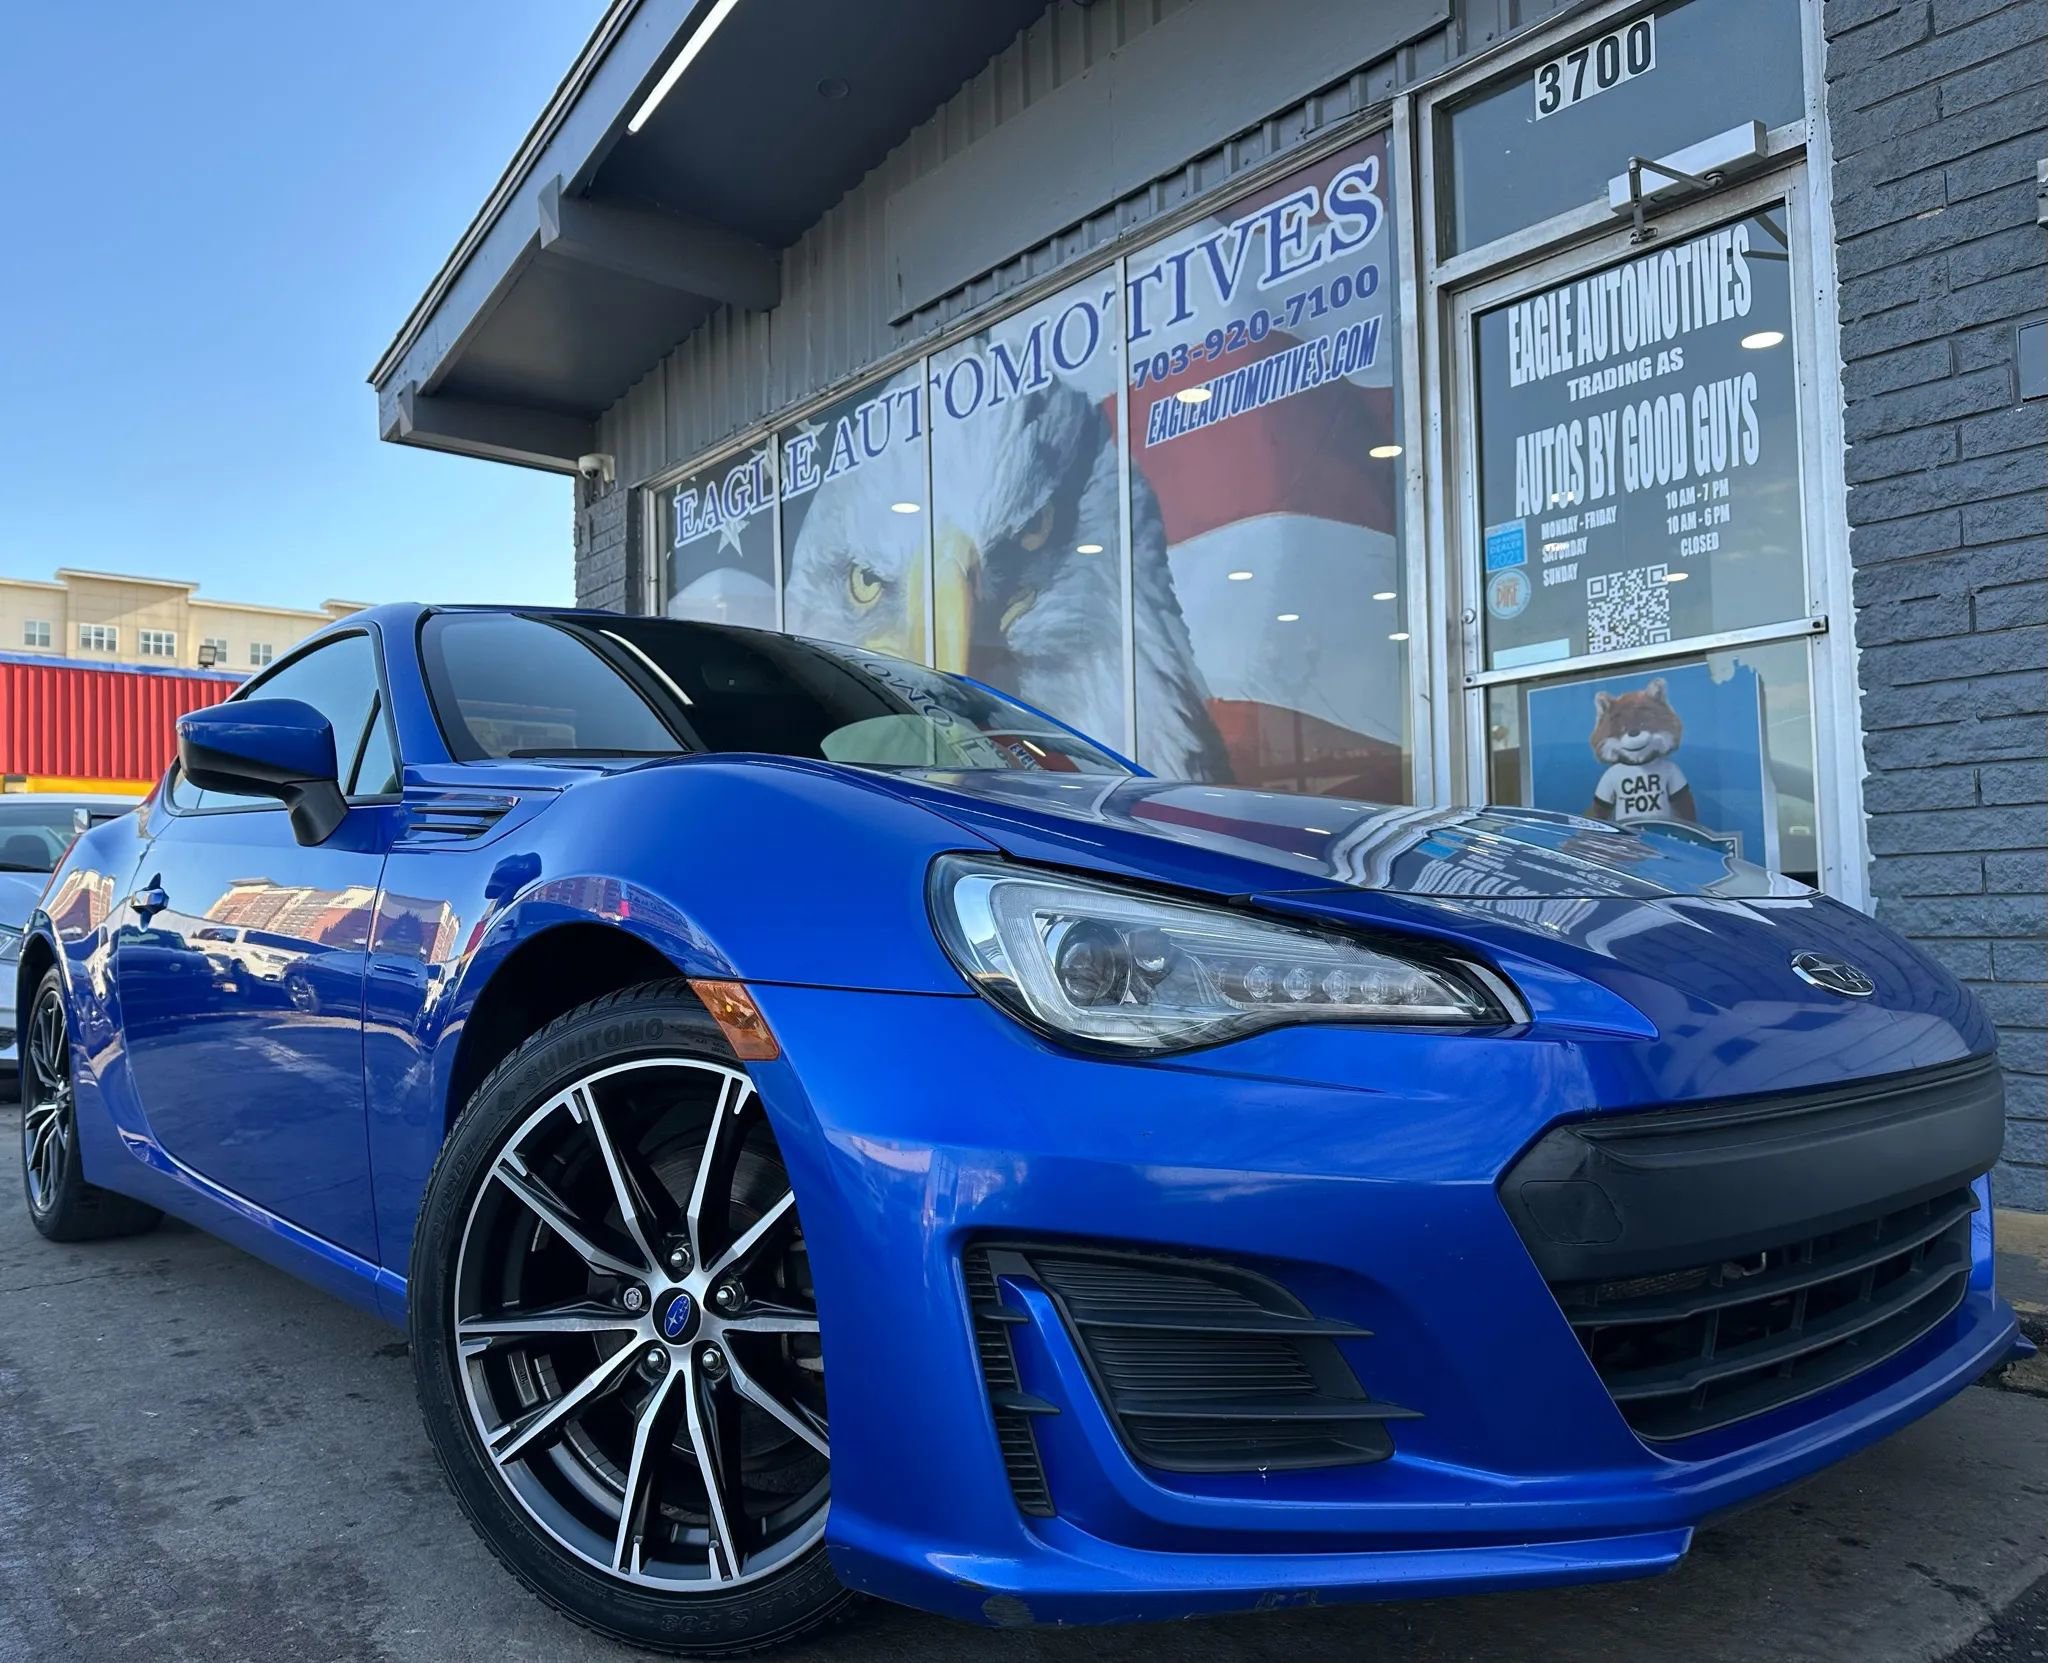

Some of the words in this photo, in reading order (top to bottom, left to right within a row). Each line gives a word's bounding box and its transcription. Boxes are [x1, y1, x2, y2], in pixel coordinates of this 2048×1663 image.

[1538, 20, 1651, 114] 3700
[1508, 285, 1573, 387] EAGLE
[1576, 224, 1751, 366] AUTOMOTIVES
[1134, 264, 1379, 389] 703-920-7100
[674, 429, 820, 548] EAGLE
[824, 155, 1384, 482] AUTOMOTIVES
[1146, 315, 1382, 448] EAGLEAUTOMOTIVES.COM
[1567, 356, 1651, 401] TRADING
[1656, 347, 1684, 375] AS
[1516, 419, 1585, 517] AUTOS
[1588, 409, 1617, 500] BY
[1622, 392, 1688, 493] GOOD
[1692, 371, 1760, 477] GUYS
[1665, 490, 1678, 510] 10
[1679, 486, 1696, 507] AM
[1702, 483, 1708, 501] 7
[1712, 478, 1729, 499] PM
[1541, 515, 1578, 540] MONDAY
[1585, 505, 1617, 529] FRIDAY
[1667, 515, 1679, 535] 10
[1681, 511, 1697, 532] AM
[1704, 507, 1712, 526] 6
[1713, 503, 1730, 524] PM
[1542, 536, 1587, 563] SATURDAY
[1681, 532, 1719, 557] CLOSED
[1543, 562, 1578, 587] SUNDAY
[1621, 774, 1661, 795] CAR
[1624, 793, 1662, 814] FOX
